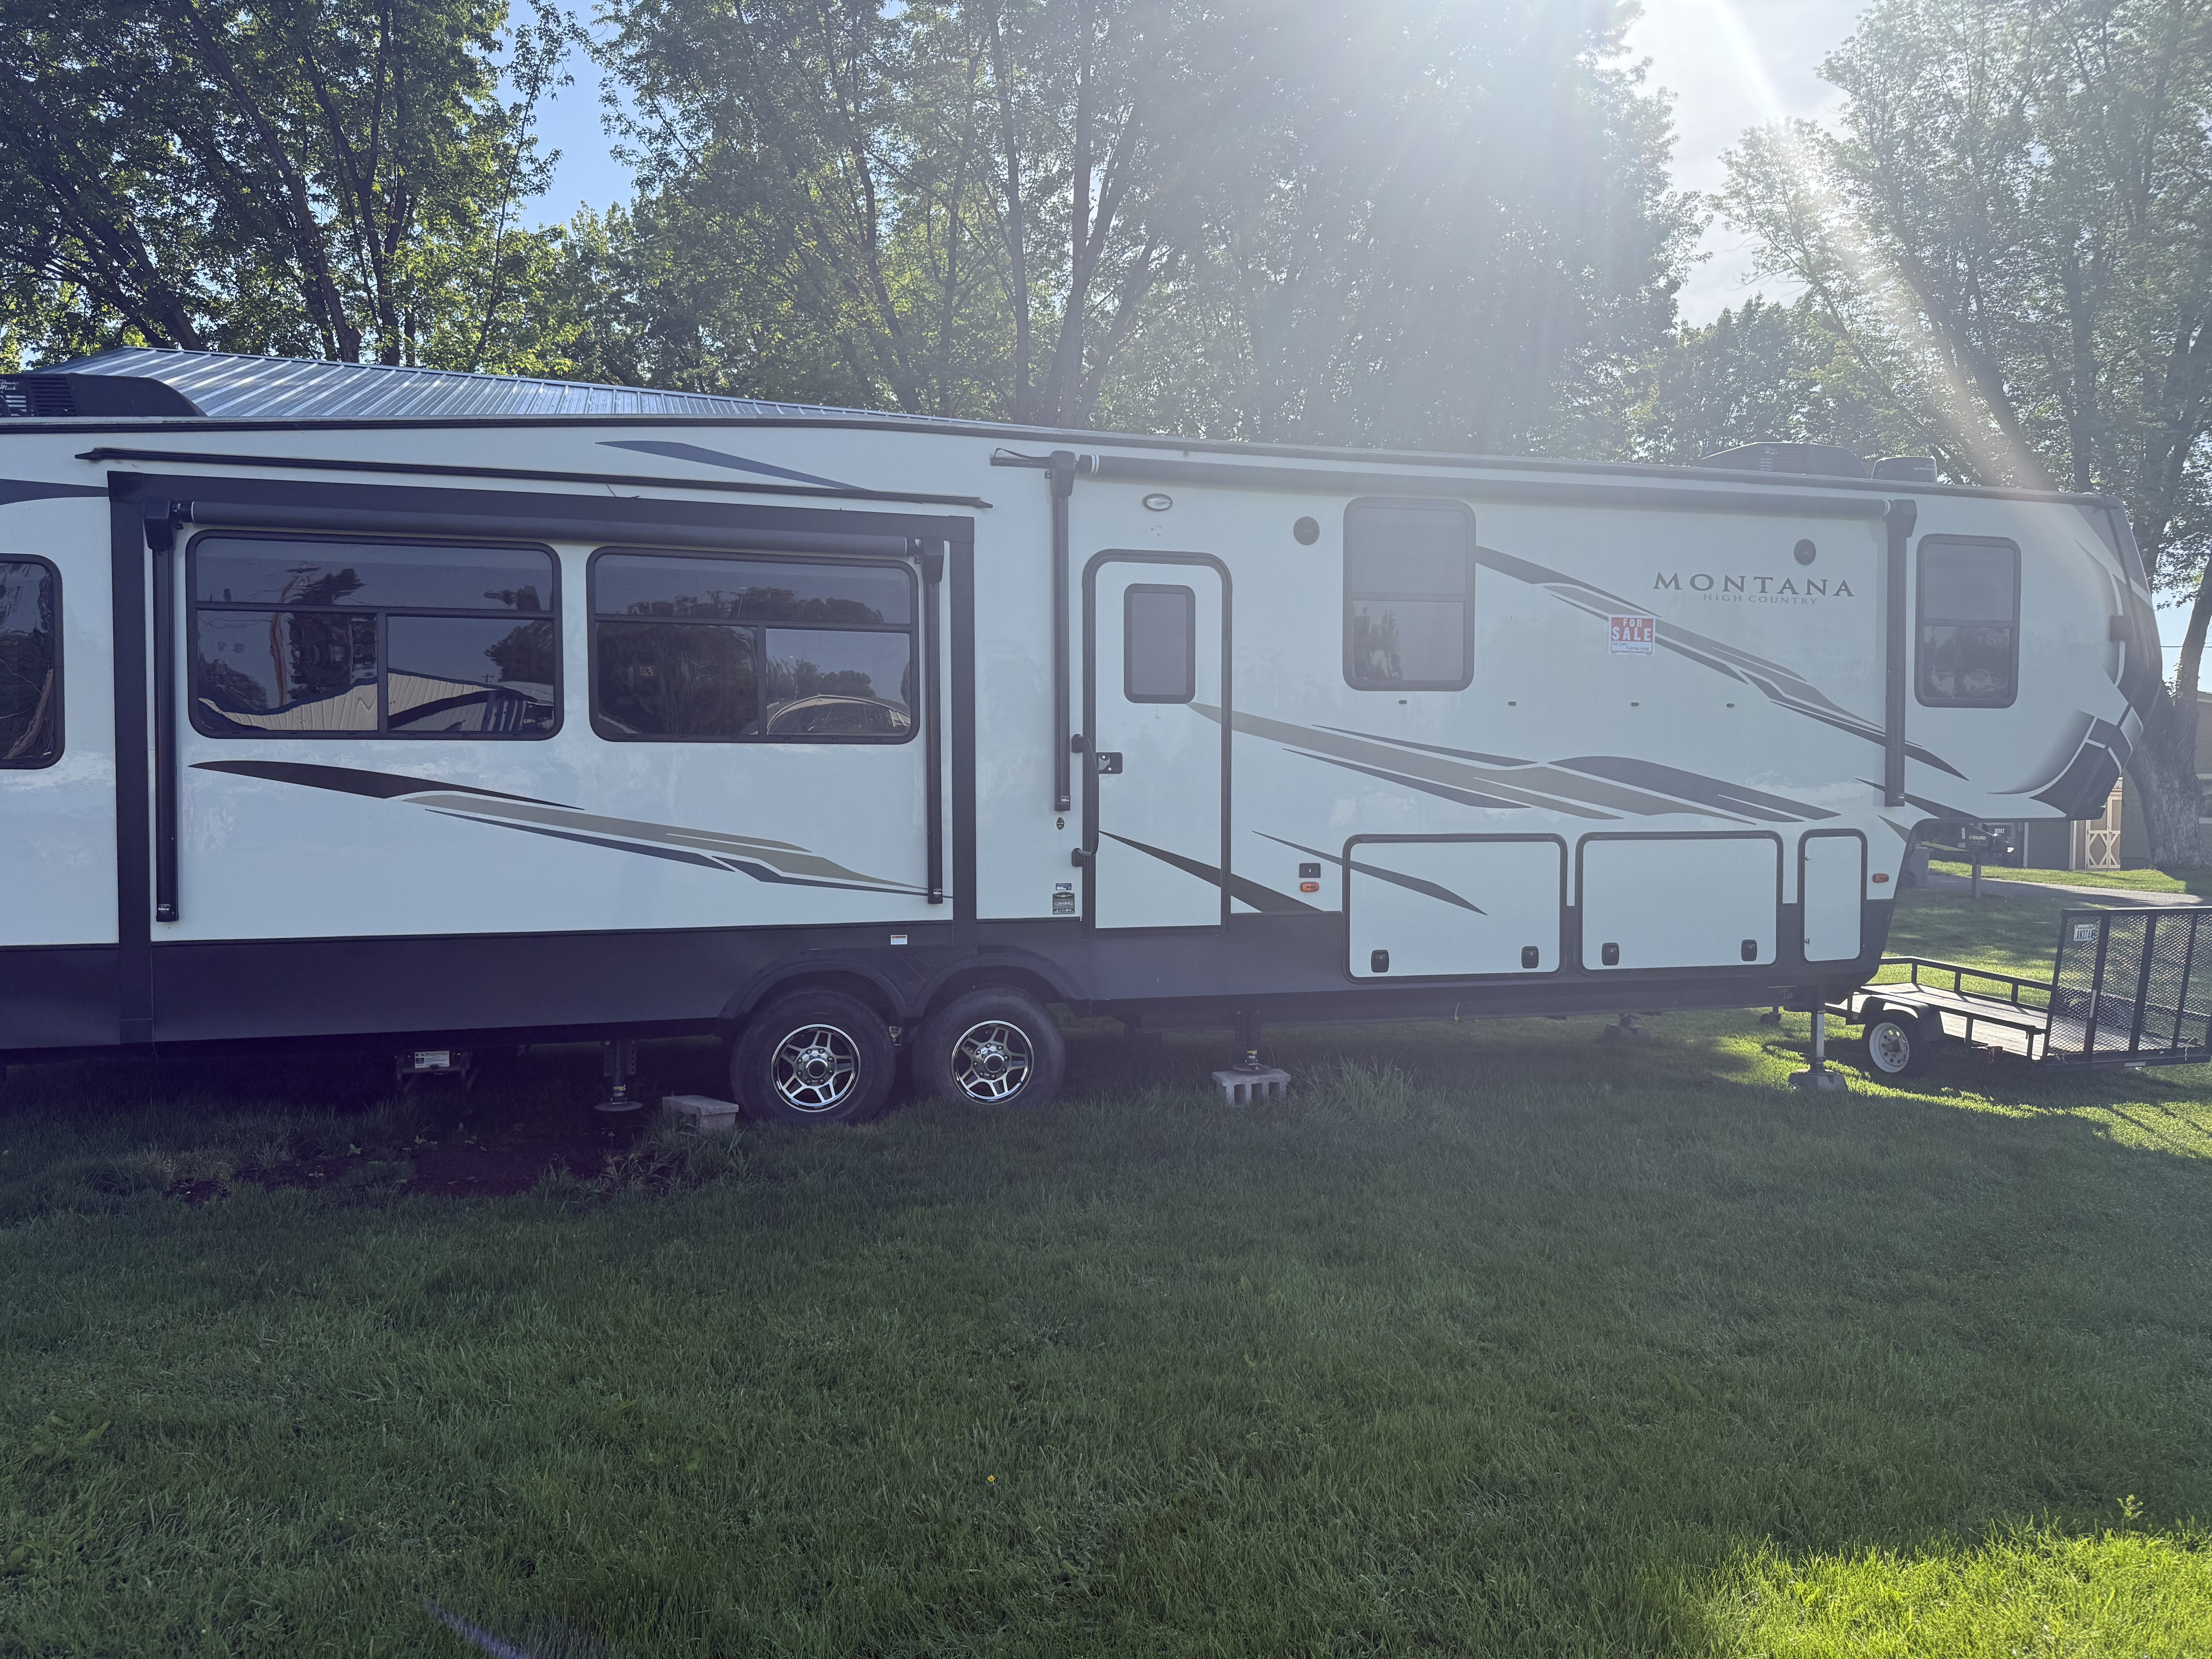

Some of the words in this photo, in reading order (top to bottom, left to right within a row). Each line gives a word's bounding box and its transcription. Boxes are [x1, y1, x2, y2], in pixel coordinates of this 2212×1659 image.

[1653, 572, 1855, 597] MONTANA
[1704, 594, 1742, 602] HIGH
[1748, 595, 1817, 605] COUNTRY
[1623, 618, 1642, 627] FOR
[1612, 626, 1651, 641] SALE
